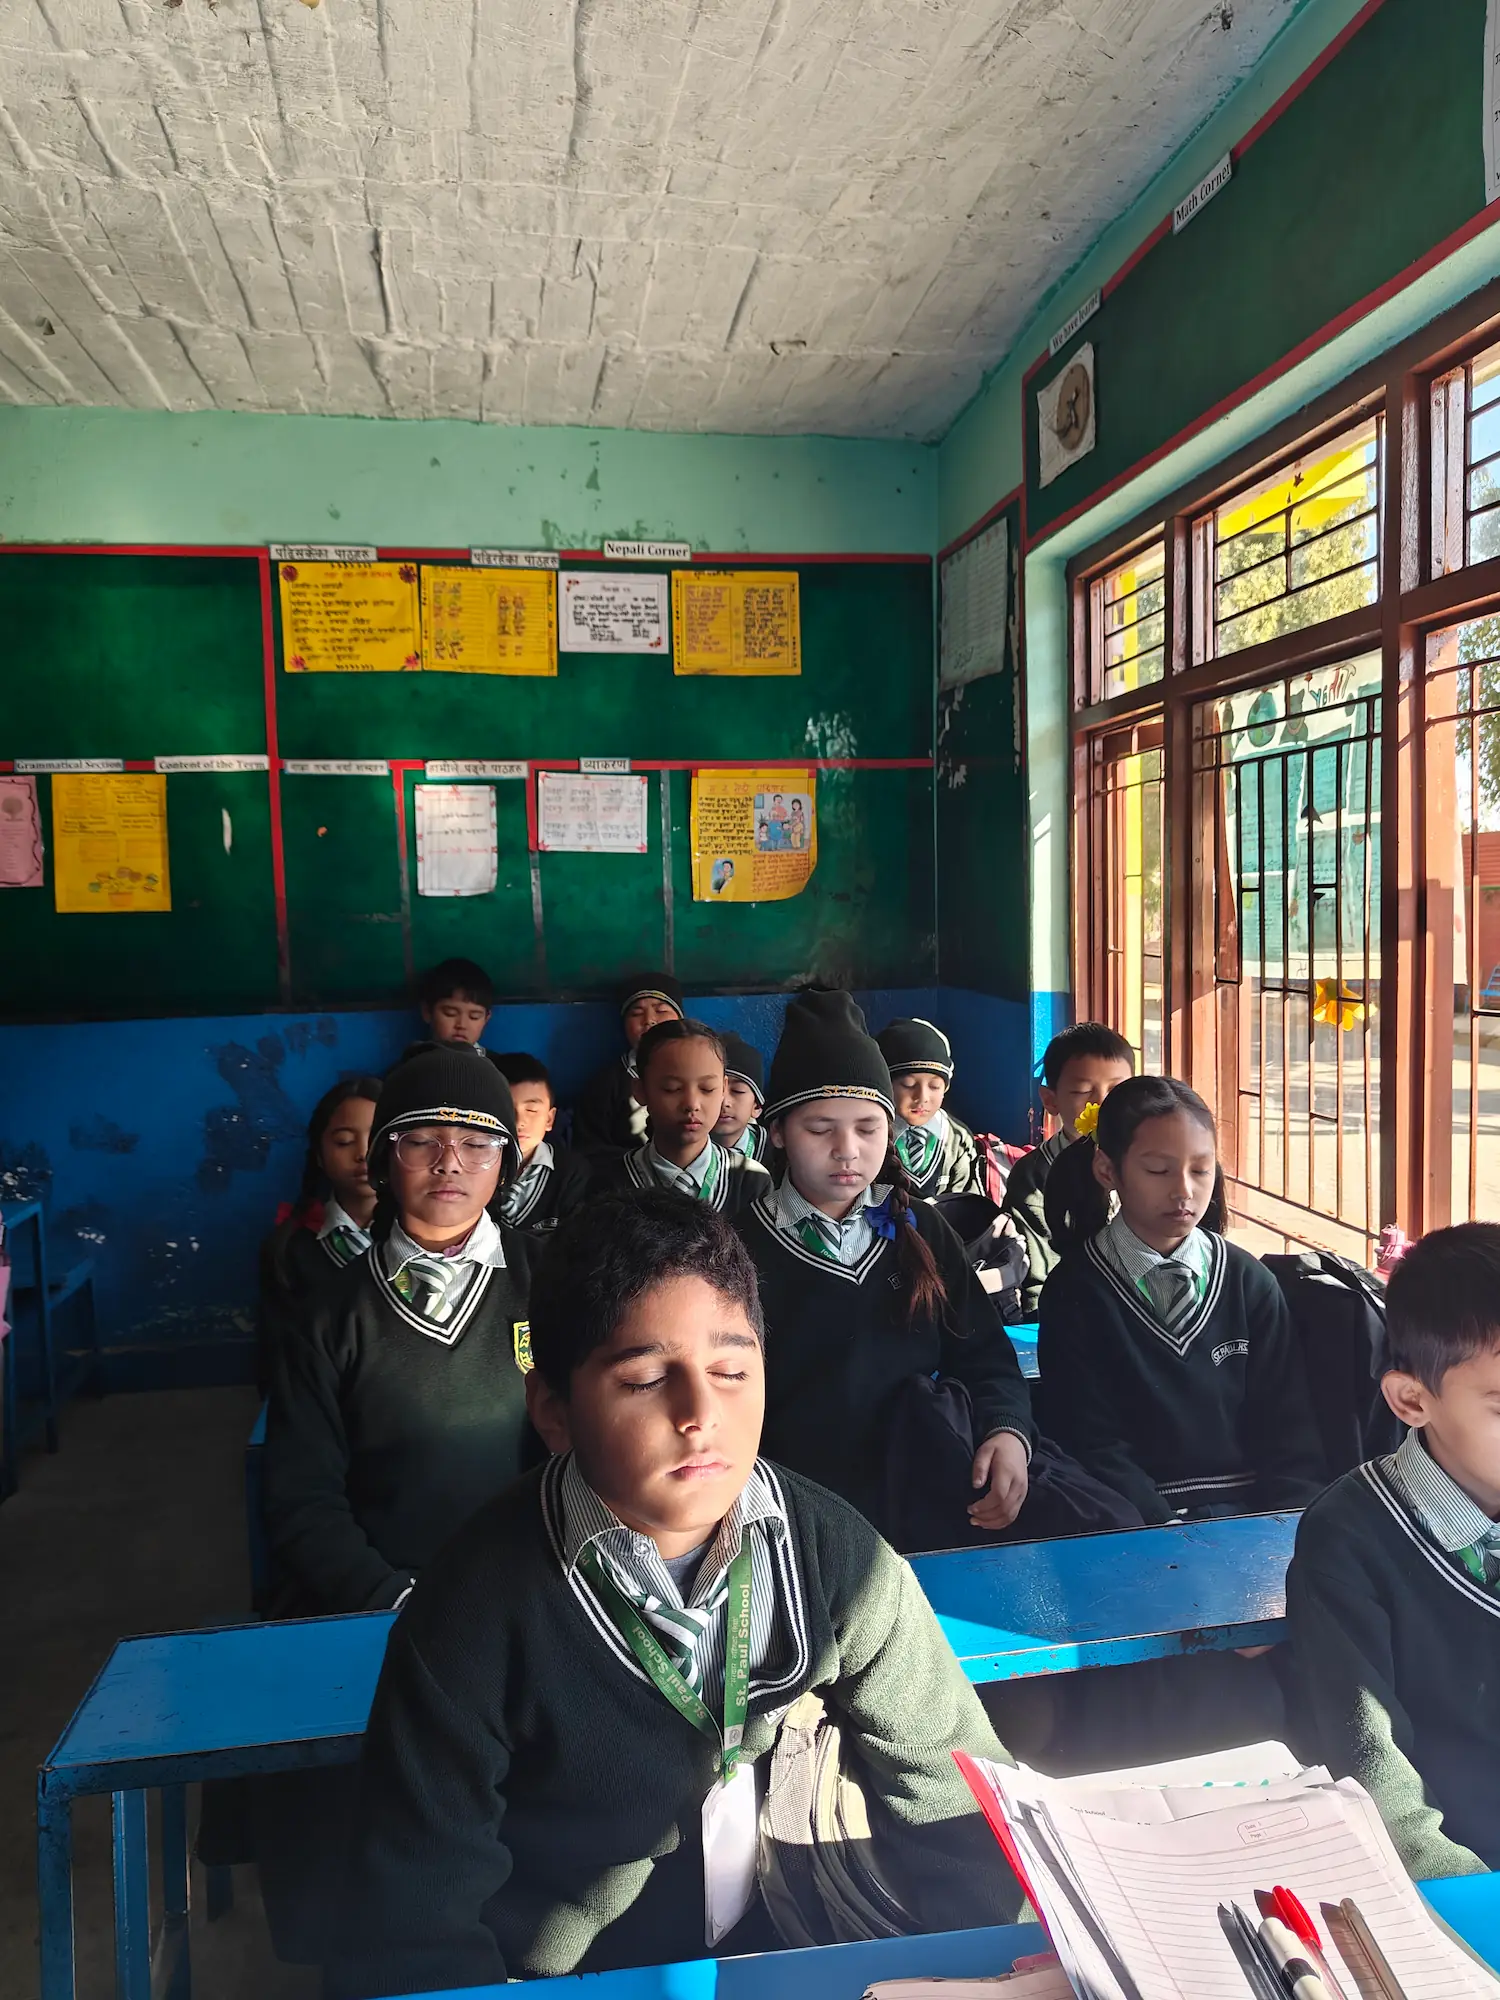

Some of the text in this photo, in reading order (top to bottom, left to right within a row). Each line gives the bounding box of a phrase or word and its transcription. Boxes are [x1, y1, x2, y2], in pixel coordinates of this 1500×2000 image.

[1175, 163, 1230, 225] Math Corner
[606, 543, 689, 558] Nepali Corner
[16, 760, 122, 770] Grammatical Section
[159, 759, 266, 770] Content of the Term
[631, 1625, 669, 1675] School
[735, 1583, 751, 1707] St. Paul School
[666, 1673, 693, 1704] Paul
[694, 1702, 707, 1719] St.
